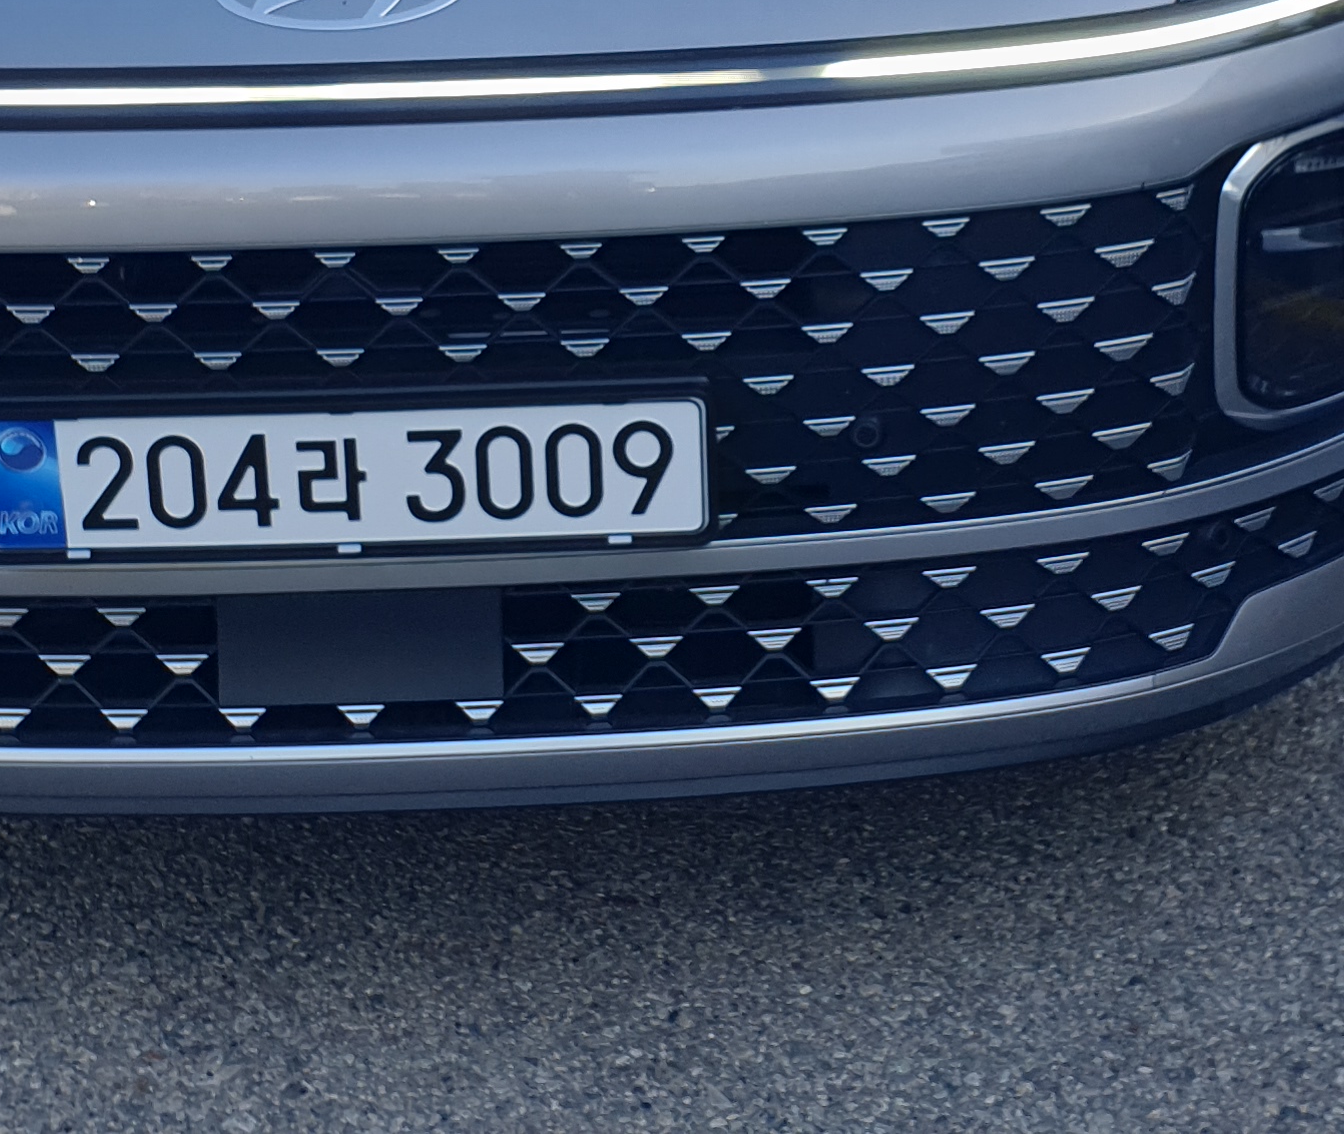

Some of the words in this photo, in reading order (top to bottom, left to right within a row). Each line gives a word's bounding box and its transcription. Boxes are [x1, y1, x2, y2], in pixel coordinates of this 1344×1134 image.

[75, 433, 367, 529] 204라
[406, 420, 674, 523] 3009
[0, 510, 59, 535] KOR
